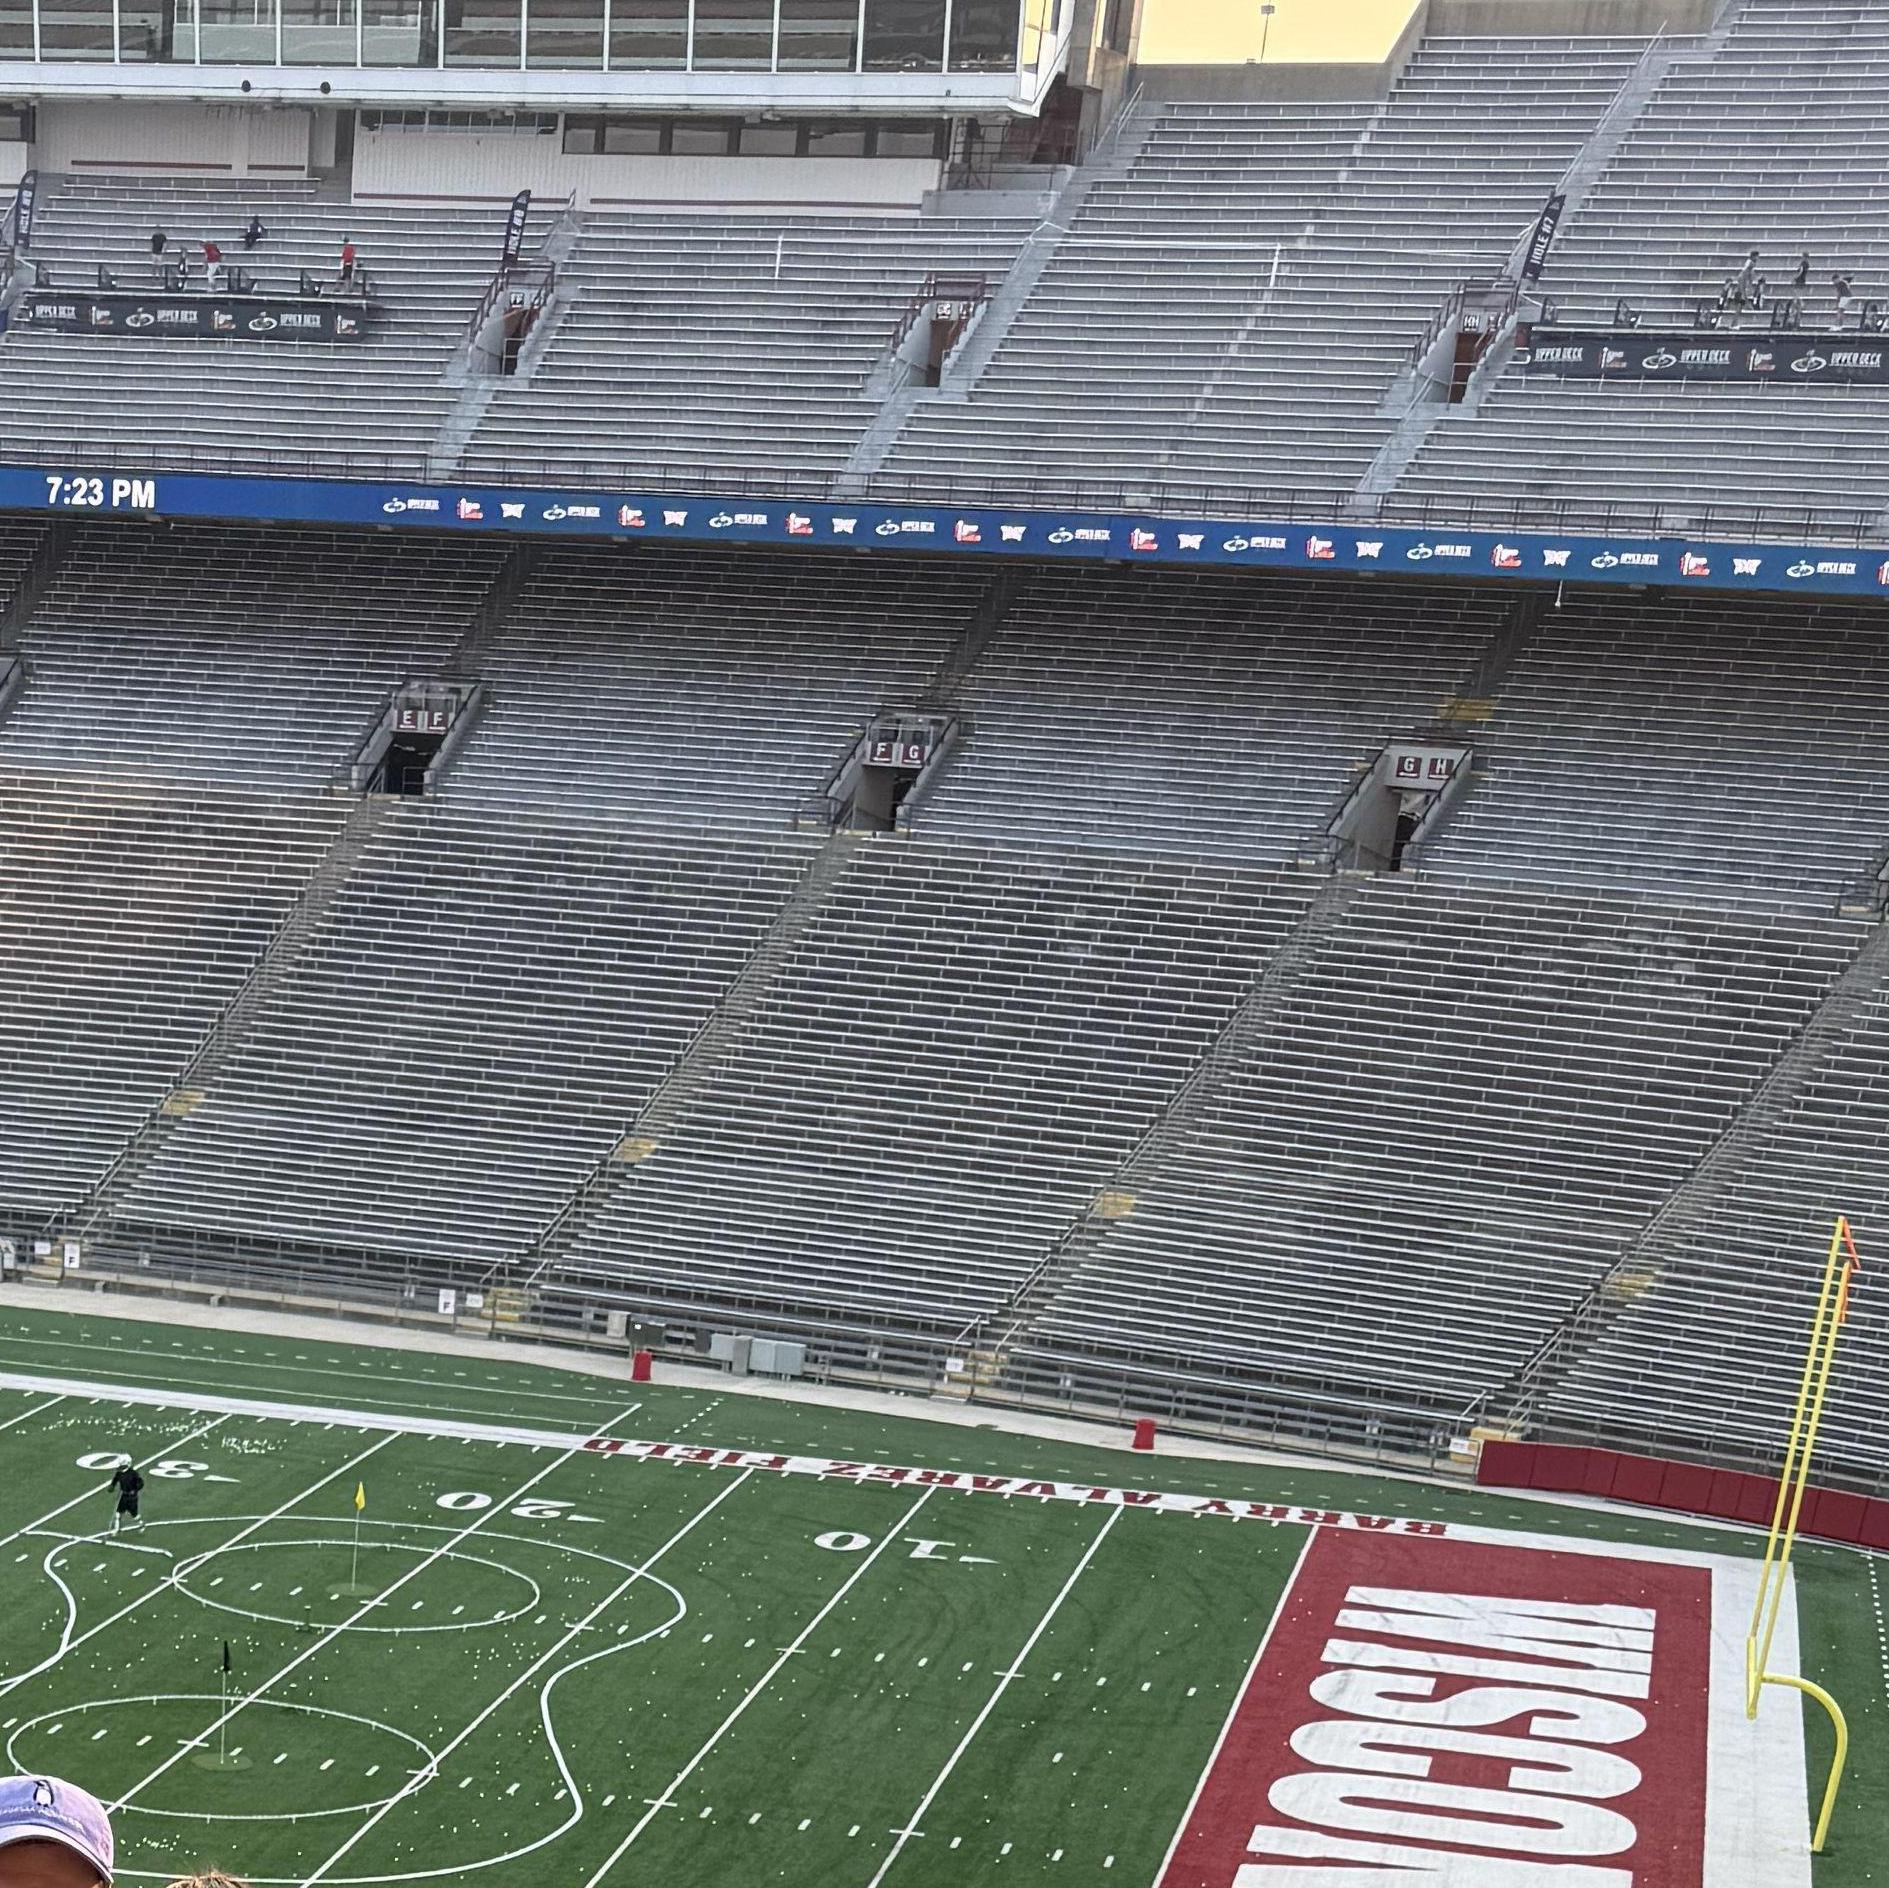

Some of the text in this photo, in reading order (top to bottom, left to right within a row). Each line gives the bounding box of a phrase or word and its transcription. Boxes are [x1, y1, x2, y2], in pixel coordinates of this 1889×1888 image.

[1530, 234, 1549, 265] HOLE
[46, 477, 155, 508] 7:23 PM
[76, 1451, 211, 1481] 30
[583, 1439, 1448, 1536] BARRY ALVAREZ FIELD
[436, 1490, 575, 1521] 20
[813, 1531, 956, 1561] 10
